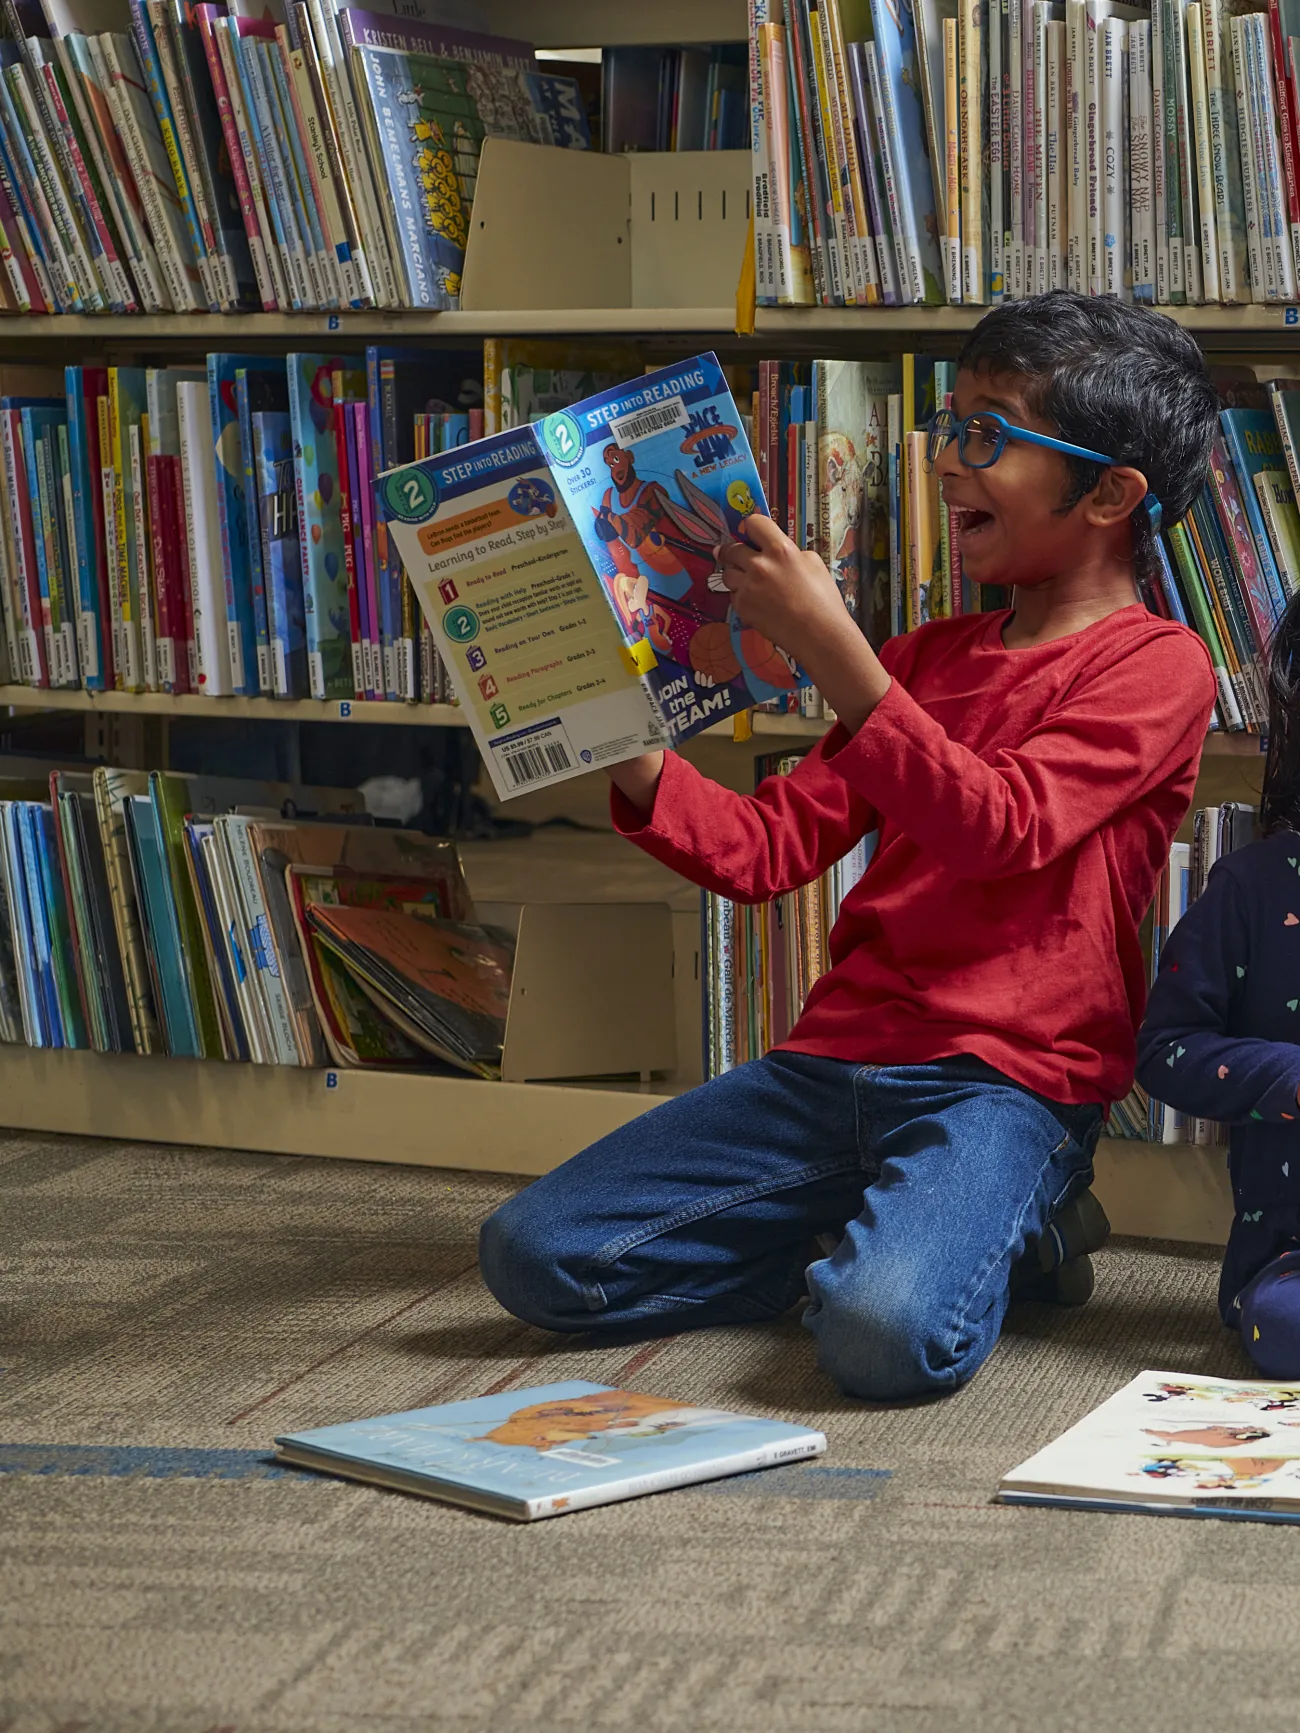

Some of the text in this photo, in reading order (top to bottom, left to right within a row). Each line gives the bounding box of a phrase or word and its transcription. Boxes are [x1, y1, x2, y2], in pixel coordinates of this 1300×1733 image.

[1205, 3, 1213, 26] JAN
[363, 28, 405, 49] KRISTEN
[410, 38, 433, 57] BELL
[440, 46, 449, 57] &
[453, 45, 503, 67] BENJAMIN
[1206, 31, 1215, 71] BRETT
[961, 89, 968, 108] ON
[1278, 80, 1287, 110] Clifford
[991, 93, 1000, 137] EASTER
[1211, 110, 1220, 139] THREE
[1284, 129, 1289, 137] to
[316, 152, 328, 180] School
[991, 140, 1000, 163] EGG
[1106, 147, 1115, 179] COZY
[1214, 143, 1223, 170] SNOW
[370, 53, 430, 305] JOHN BEMELMANS MARCIANO
[1139, 134, 1149, 211] SNOWY NAP
[1285, 138, 1294, 197] Kindergarten
[762, 173, 770, 218] Bradfield
[1215, 176, 1225, 205] BEARS
[327, 316, 339, 330] B
[1285, 307, 1299, 325] B
[586, 370, 705, 428] STEP INTO READING
[681, 405, 723, 438] SPACE
[555, 425, 574, 454] 2
[694, 435, 737, 468] JAM
[442, 441, 536, 484] STEP INTO READING
[580, 467, 592, 479] 30
[700, 464, 717, 476] NEW
[719, 454, 748, 470] LEGACY
[403, 480, 424, 509] 2
[342, 509, 353, 569] PIG PUG
[428, 517, 567, 573] Learning to Read, Step by Step!
[466, 574, 485, 587] Ready
[485, 573, 492, 581] to
[492, 568, 507, 579] Read
[445, 585, 454, 600] 1
[475, 596, 499, 609] Reading
[500, 591, 513, 601] with
[514, 587, 527, 598] Help
[457, 616, 471, 635] 2
[494, 641, 518, 654] Reading
[527, 632, 541, 643] Your
[541, 629, 556, 639] Own
[558, 622, 577, 633] Grades
[472, 652, 484, 668] 3
[506, 671, 530, 683] Reading
[531, 659, 563, 675] Paragraphs
[566, 652, 585, 662] Grades
[484, 679, 496, 695] 4
[518, 701, 537, 712] Ready
[537, 697, 547, 706] for
[547, 689, 573, 703] Chapters
[576, 682, 595, 692] Grades
[658, 675, 688, 704] JOIN
[340, 703, 352, 717] B
[495, 705, 508, 721] 5
[667, 689, 731, 736] TEAM!
[669, 692, 696, 713] the
[723, 959, 734, 1063] Gail de Marcken
[326, 1072, 338, 1088] B
